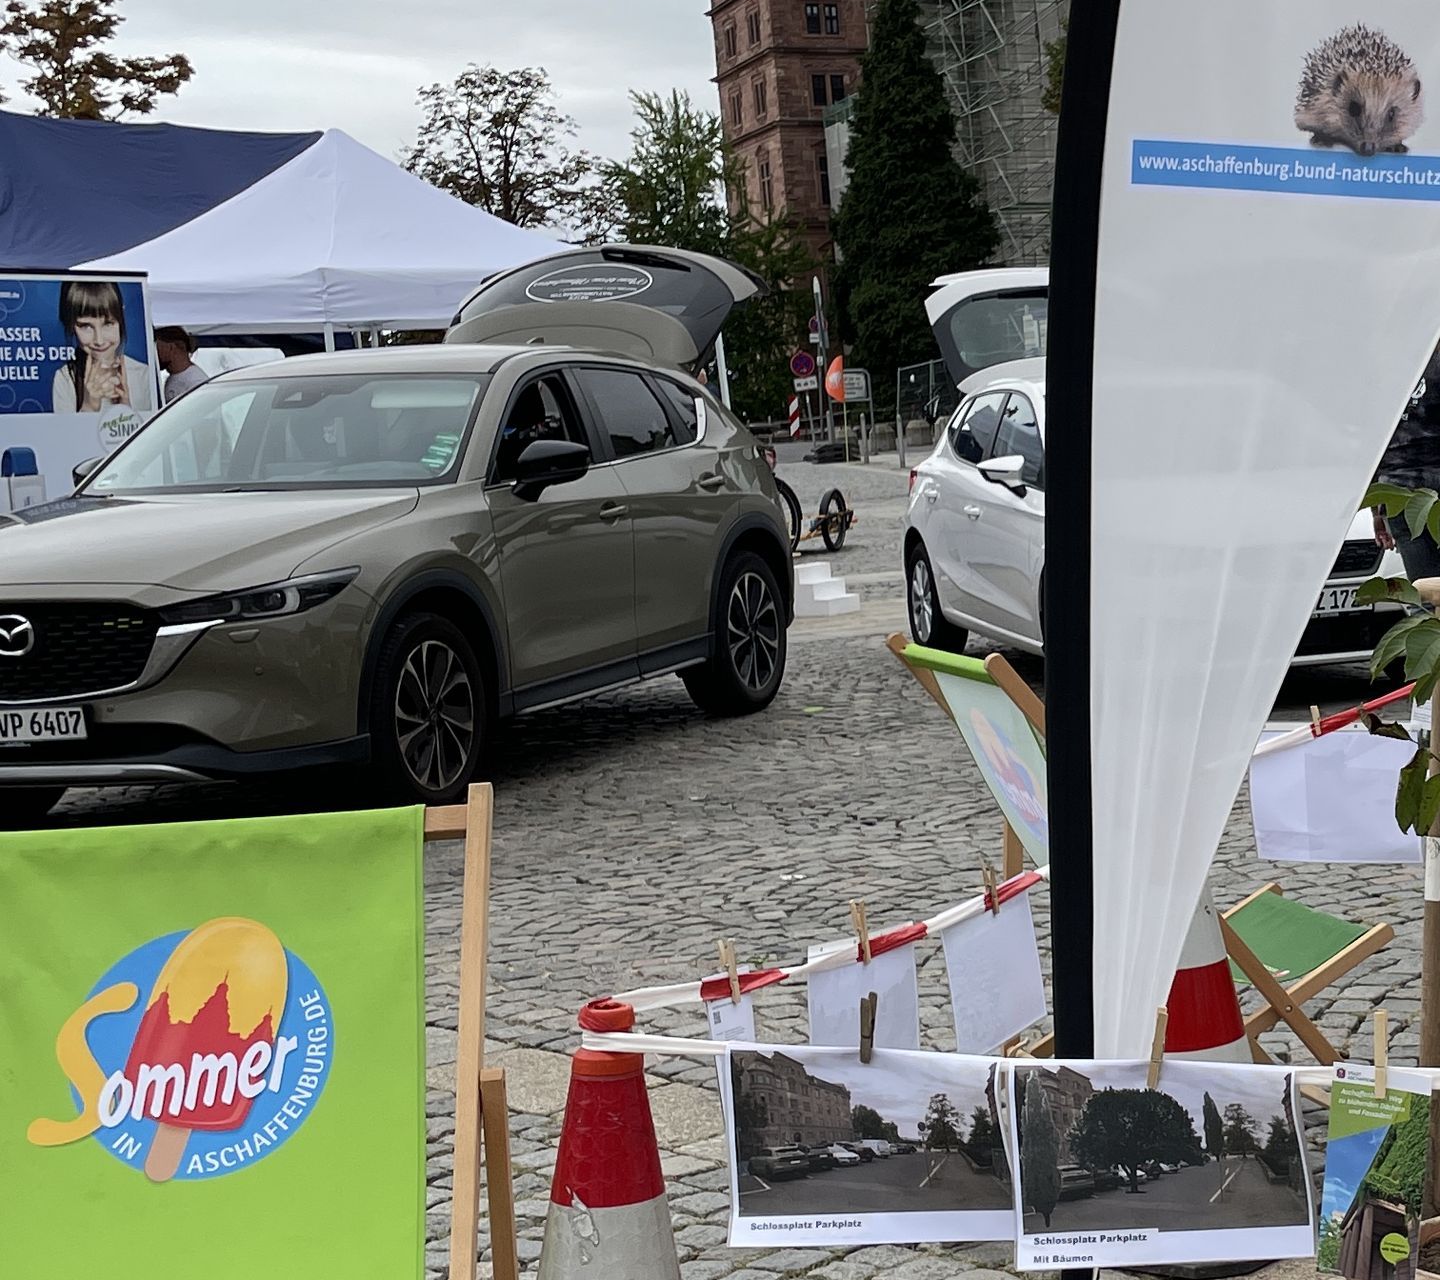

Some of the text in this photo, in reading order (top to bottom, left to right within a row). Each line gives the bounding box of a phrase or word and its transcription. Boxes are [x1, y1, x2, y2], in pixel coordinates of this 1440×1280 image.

[15, 347, 46, 361] AUS
[49, 347, 76, 361] DER
[30, 710, 81, 736] 6407
[27, 981, 299, 1147] Sommer
[111, 989, 329, 1175] IN ASCHAFFENBURG.DE
[750, 1219, 862, 1231] Schlossplatz Parkplatz
[1033, 1233, 1148, 1246] Schlossplatz Parkplatz
[1033, 1252, 1094, 1264] Mit Bäumen
